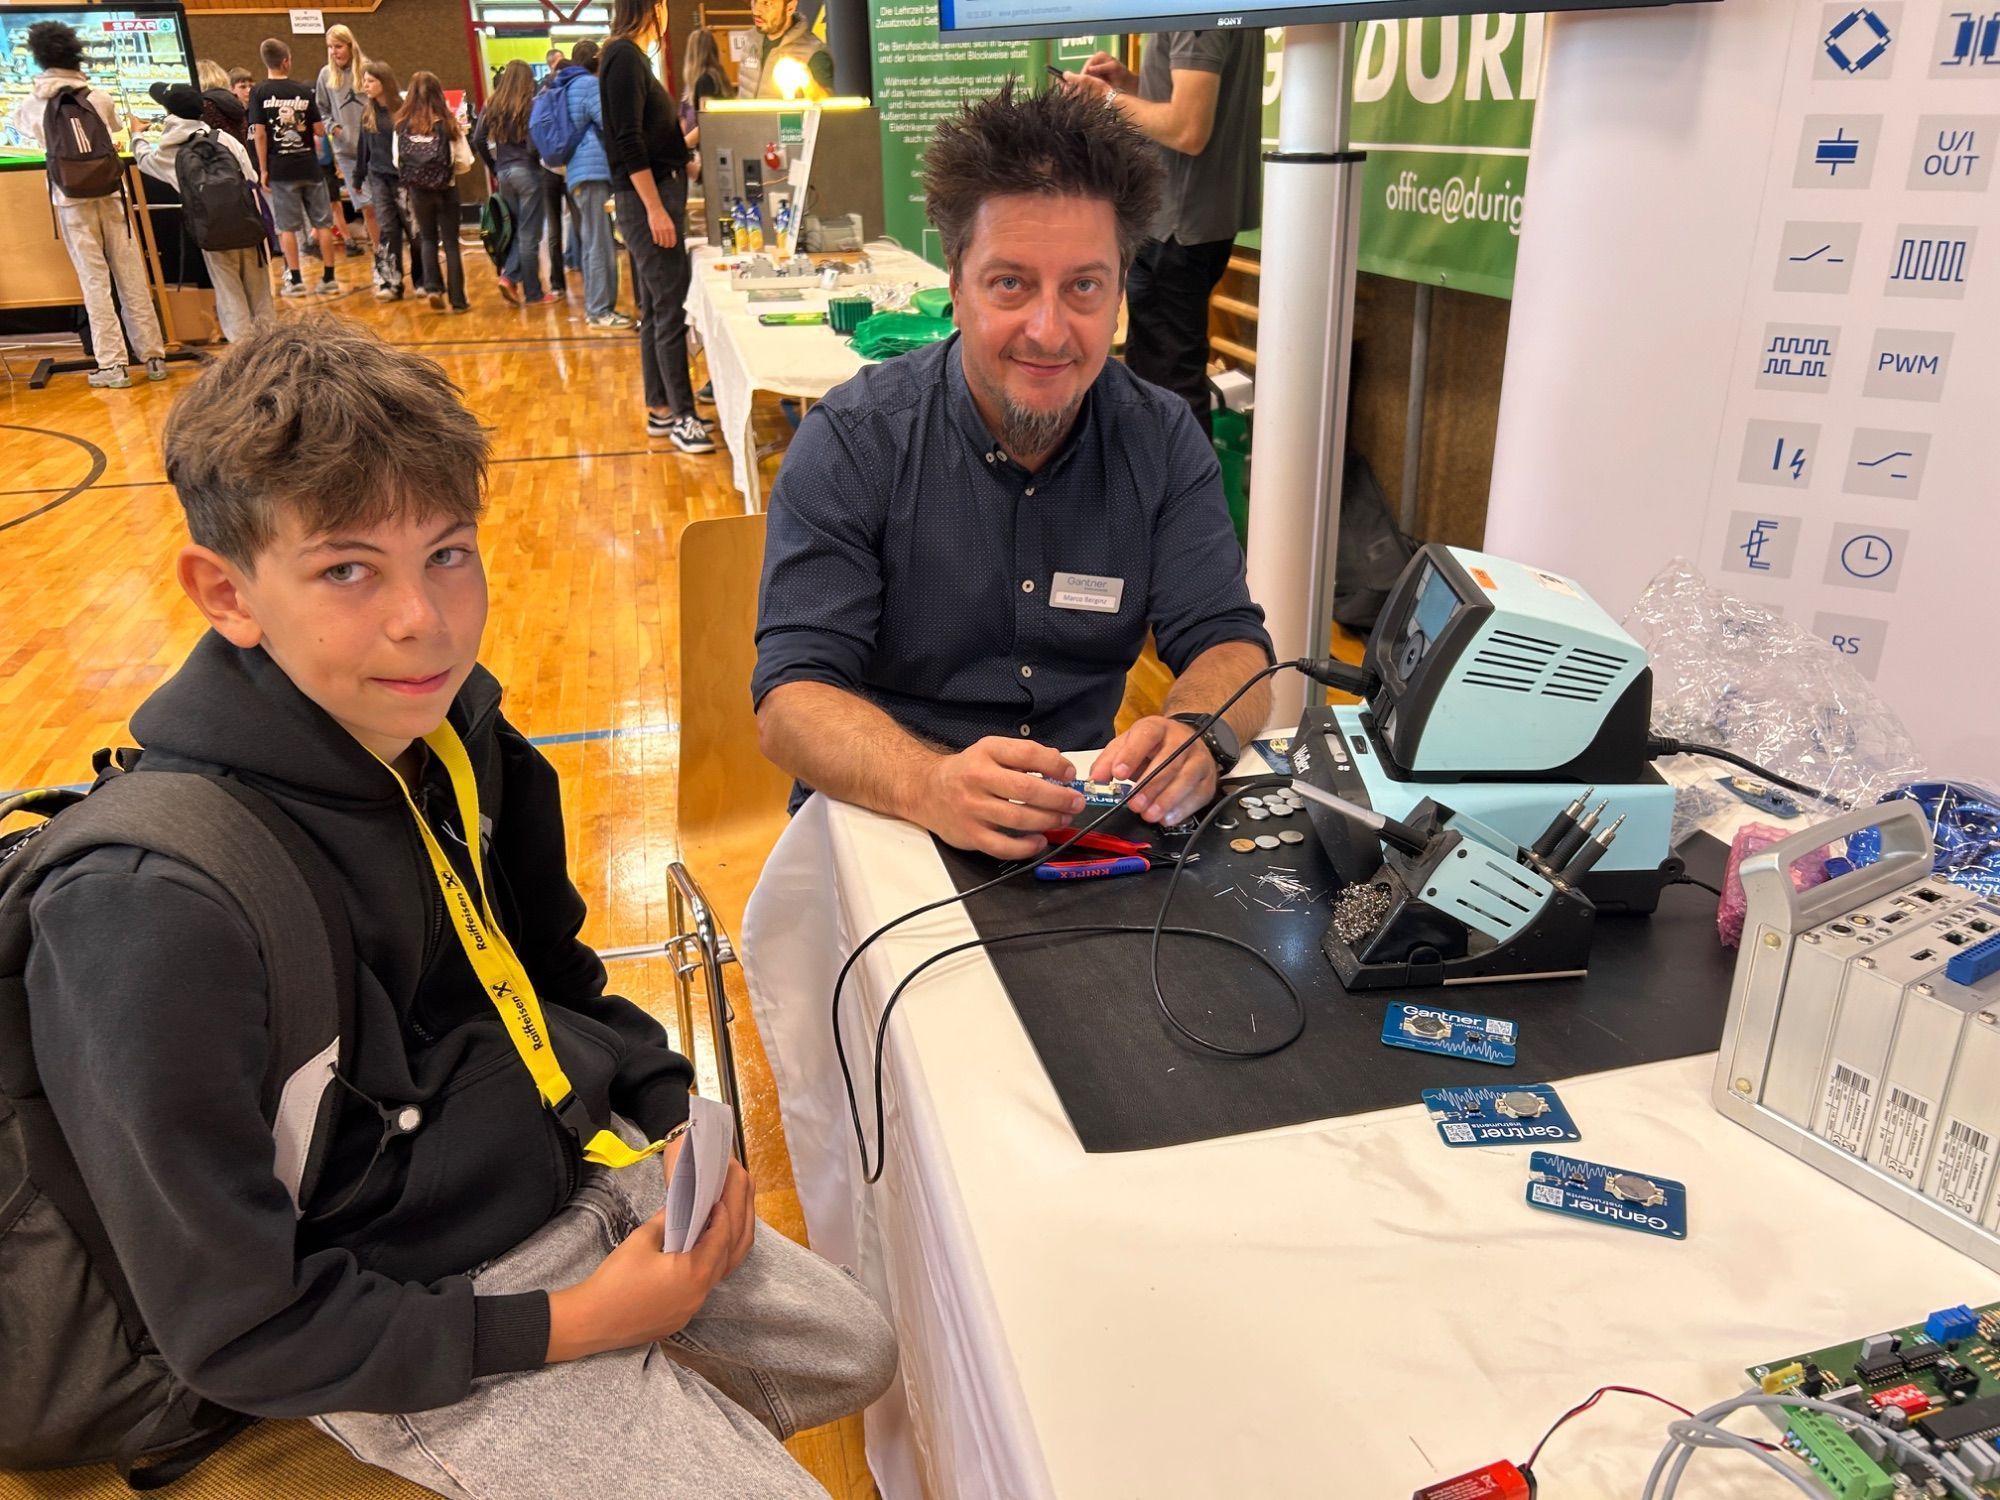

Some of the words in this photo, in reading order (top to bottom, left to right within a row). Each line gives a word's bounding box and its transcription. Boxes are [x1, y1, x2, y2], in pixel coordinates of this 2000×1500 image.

[112, 21, 156, 31] SPAR
[1217, 17, 1243, 26] SONY
[1938, 130, 1975, 151] U/I
[1924, 155, 1980, 176] OUT
[1878, 352, 1939, 375] PWM
[1067, 576, 1107, 588] Gantner
[1060, 868, 1109, 879] KNIPEX
[456, 893, 488, 951] Raiffeisen
[512, 996, 544, 1051] Raiffeisen
[1403, 1005, 1482, 1026] Gantner
[1480, 1125, 1564, 1139] Gantner
[1565, 1191, 1623, 1210] instruments
[1569, 1199, 1668, 1231] Gantner
